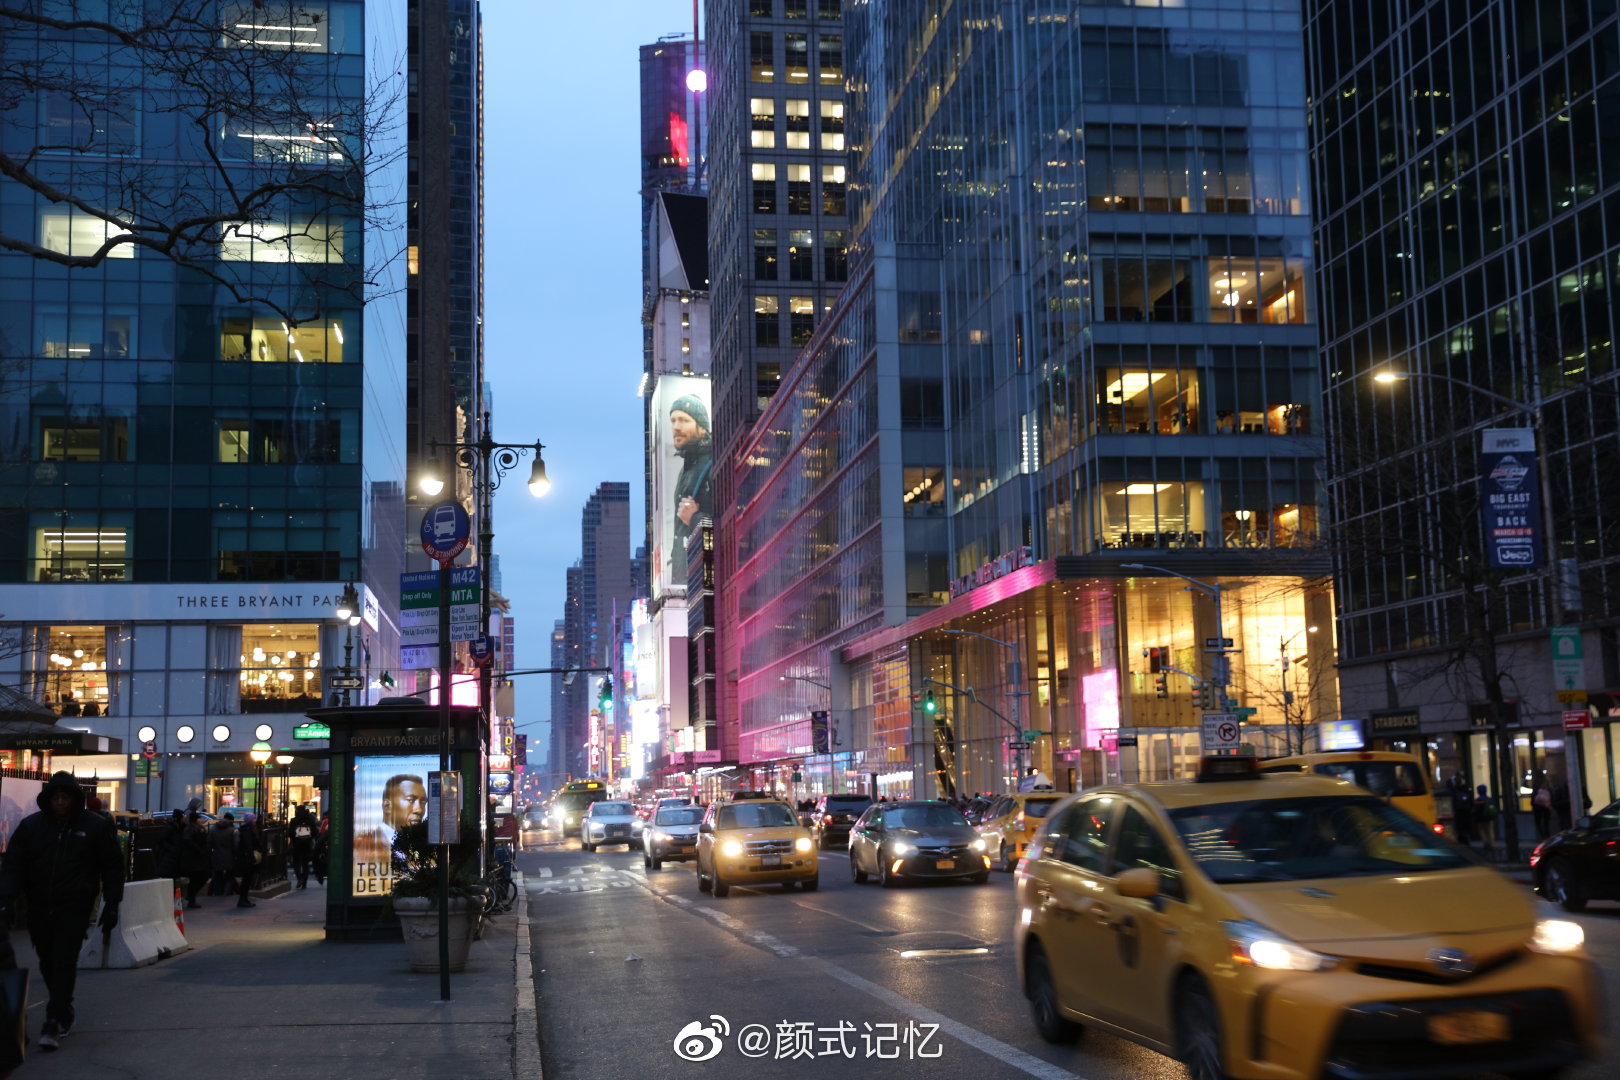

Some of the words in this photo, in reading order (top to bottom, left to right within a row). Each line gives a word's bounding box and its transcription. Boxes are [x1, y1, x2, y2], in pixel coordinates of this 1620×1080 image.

[1489, 494, 1506, 504] BIG
[1507, 492, 1530, 504] EAST
[1496, 516, 1528, 526] BACK
[435, 542, 464, 558] STANDING
[1502, 550, 1530, 560] Jeep
[452, 569, 476, 584] M42
[177, 596, 229, 608] THREE
[238, 595, 303, 607] BRYANT
[312, 595, 346, 606] PAR
[452, 589, 473, 602] MTA
[1375, 714, 1418, 729] STARBUCKS
[350, 736, 392, 747] BRYANT
[394, 735, 421, 746] PARK
[424, 735, 455, 745] NES
